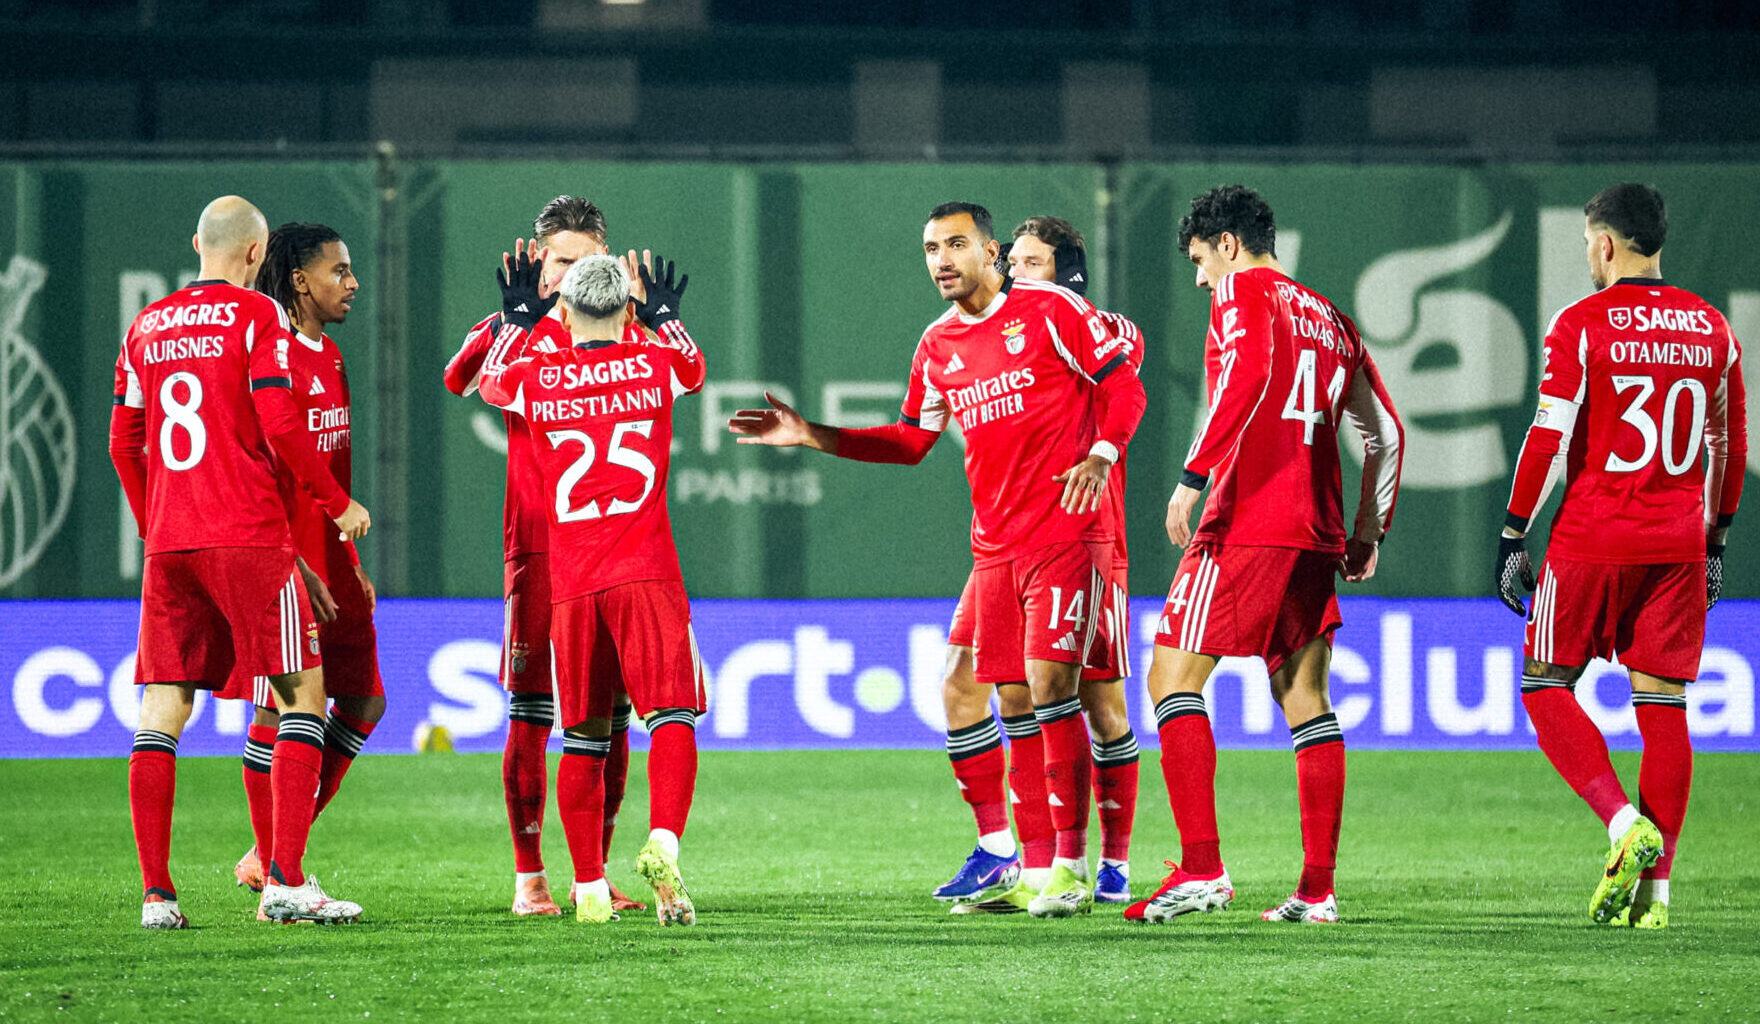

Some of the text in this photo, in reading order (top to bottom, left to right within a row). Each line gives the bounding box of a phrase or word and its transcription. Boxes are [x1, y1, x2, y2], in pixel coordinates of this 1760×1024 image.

[157, 302, 239, 332] SAGRES
[1634, 305, 1713, 336] SAGRES
[143, 335, 224, 366] AURSNES
[1609, 341, 1713, 368] OTAMENDI
[563, 353, 653, 390] SAGRES
[946, 367, 1036, 413] Emirates
[159, 371, 207, 472] 8
[531, 387, 663, 422] PRESTIANNI
[962, 392, 1025, 431] FLY BETTER
[1604, 375, 1707, 476] 30
[544, 419, 656, 524] 25
[1047, 586, 1086, 632] 14
